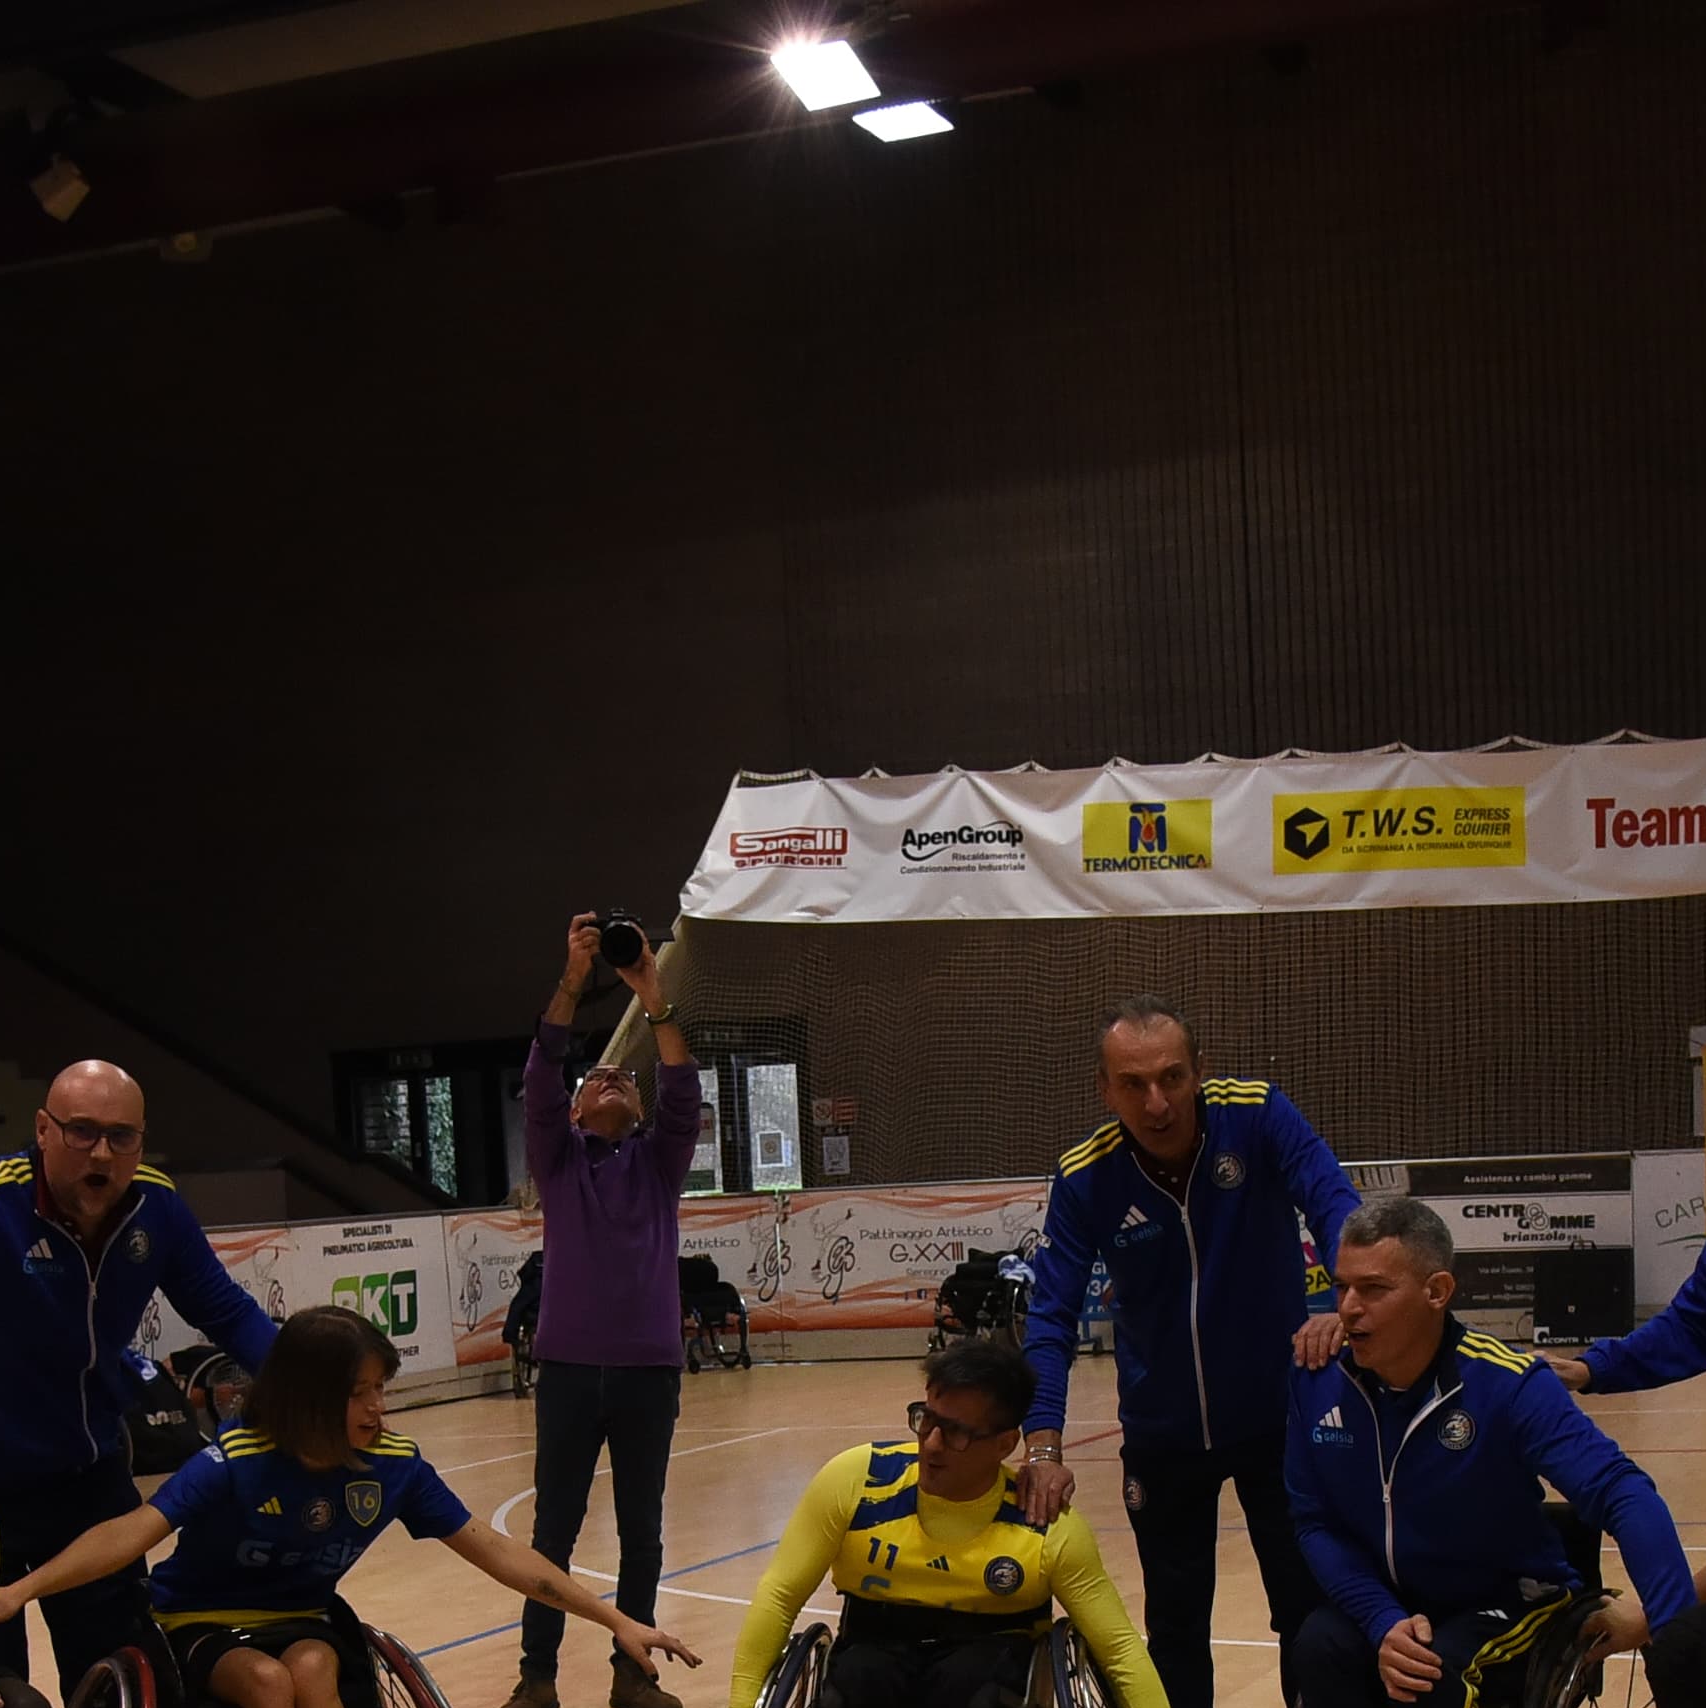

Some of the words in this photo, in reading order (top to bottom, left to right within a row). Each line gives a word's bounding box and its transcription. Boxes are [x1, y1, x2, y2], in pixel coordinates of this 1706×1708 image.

[1341, 806, 1443, 839] T.W.S.
[1453, 808, 1511, 821] EXPRESS
[1453, 822, 1511, 836] COURIER
[735, 828, 843, 853] Sangalli
[901, 825, 1024, 851] ApenGroup
[734, 855, 843, 868] SPURGHI
[951, 852, 1018, 862] Riscaldamento
[1084, 854, 1207, 873] TERMOTECNICA
[900, 864, 976, 875] Condizionamento
[978, 862, 1026, 873] Industriale
[1463, 1175, 1513, 1183] Assistenza
[1523, 1173, 1557, 1182] cambio
[1559, 1172, 1592, 1182] gomme
[343, 1225, 384, 1238] SPECIALISTI
[385, 1224, 393, 1234] DI
[859, 1227, 933, 1242] Pattinaggio
[937, 1224, 993, 1238] Artistico
[323, 1242, 366, 1256] PNEUMATICI
[367, 1238, 414, 1252] AGRICOLTURA
[683, 1236, 740, 1249] Artistico
[352, 1491, 376, 1510] 16
[867, 1536, 900, 1572] 11
